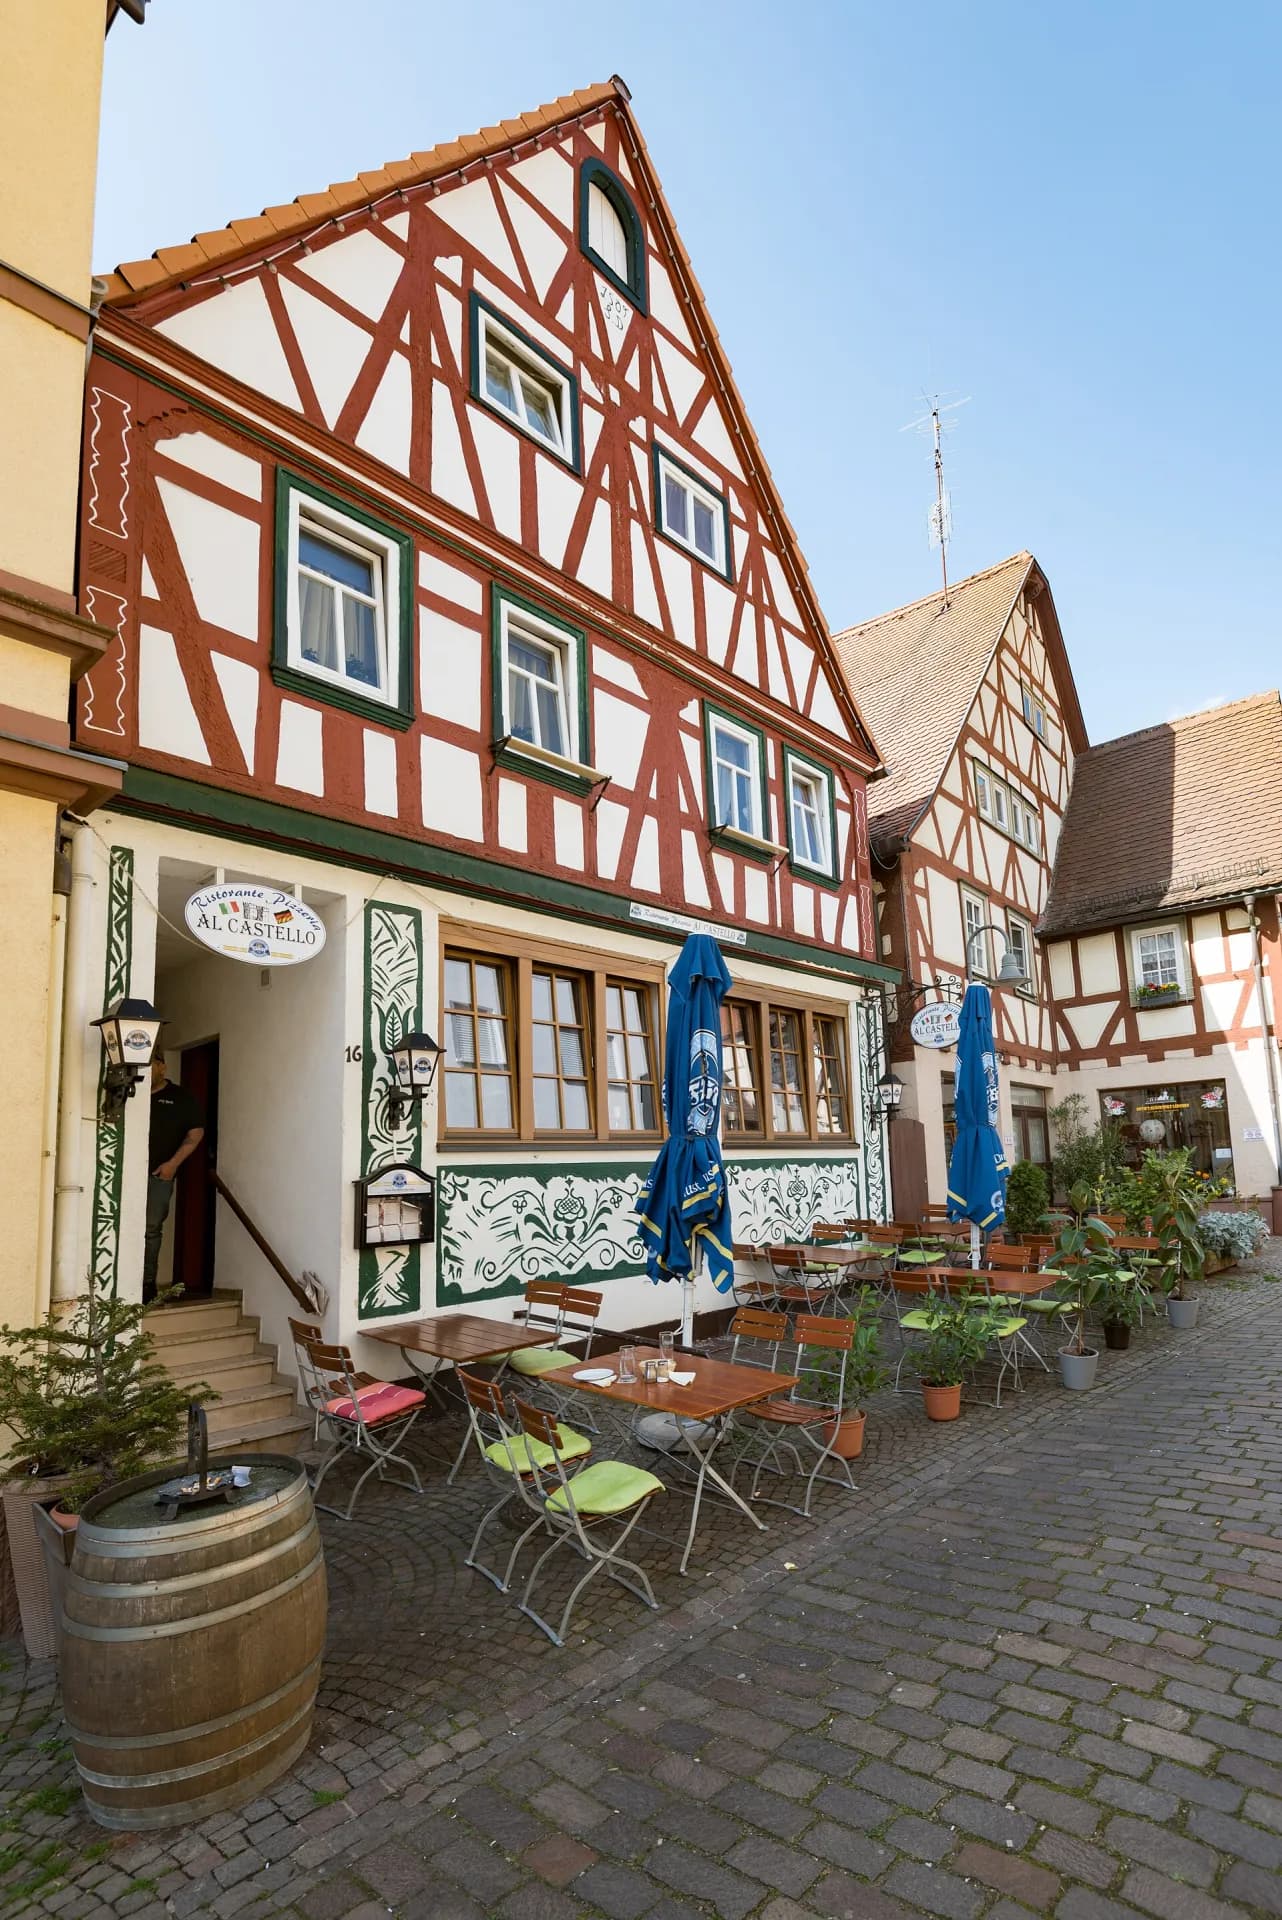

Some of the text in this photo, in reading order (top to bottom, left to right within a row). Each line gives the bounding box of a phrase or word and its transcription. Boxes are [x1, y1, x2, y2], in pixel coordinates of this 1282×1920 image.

[191, 889, 321, 931] Ristorante Pizzeria
[197, 913, 316, 945] AL CASTELLO
[703, 922, 737, 940] CASTELLO
[914, 1022, 960, 1036] AL CASTELL
[345, 1045, 362, 1063] 16
